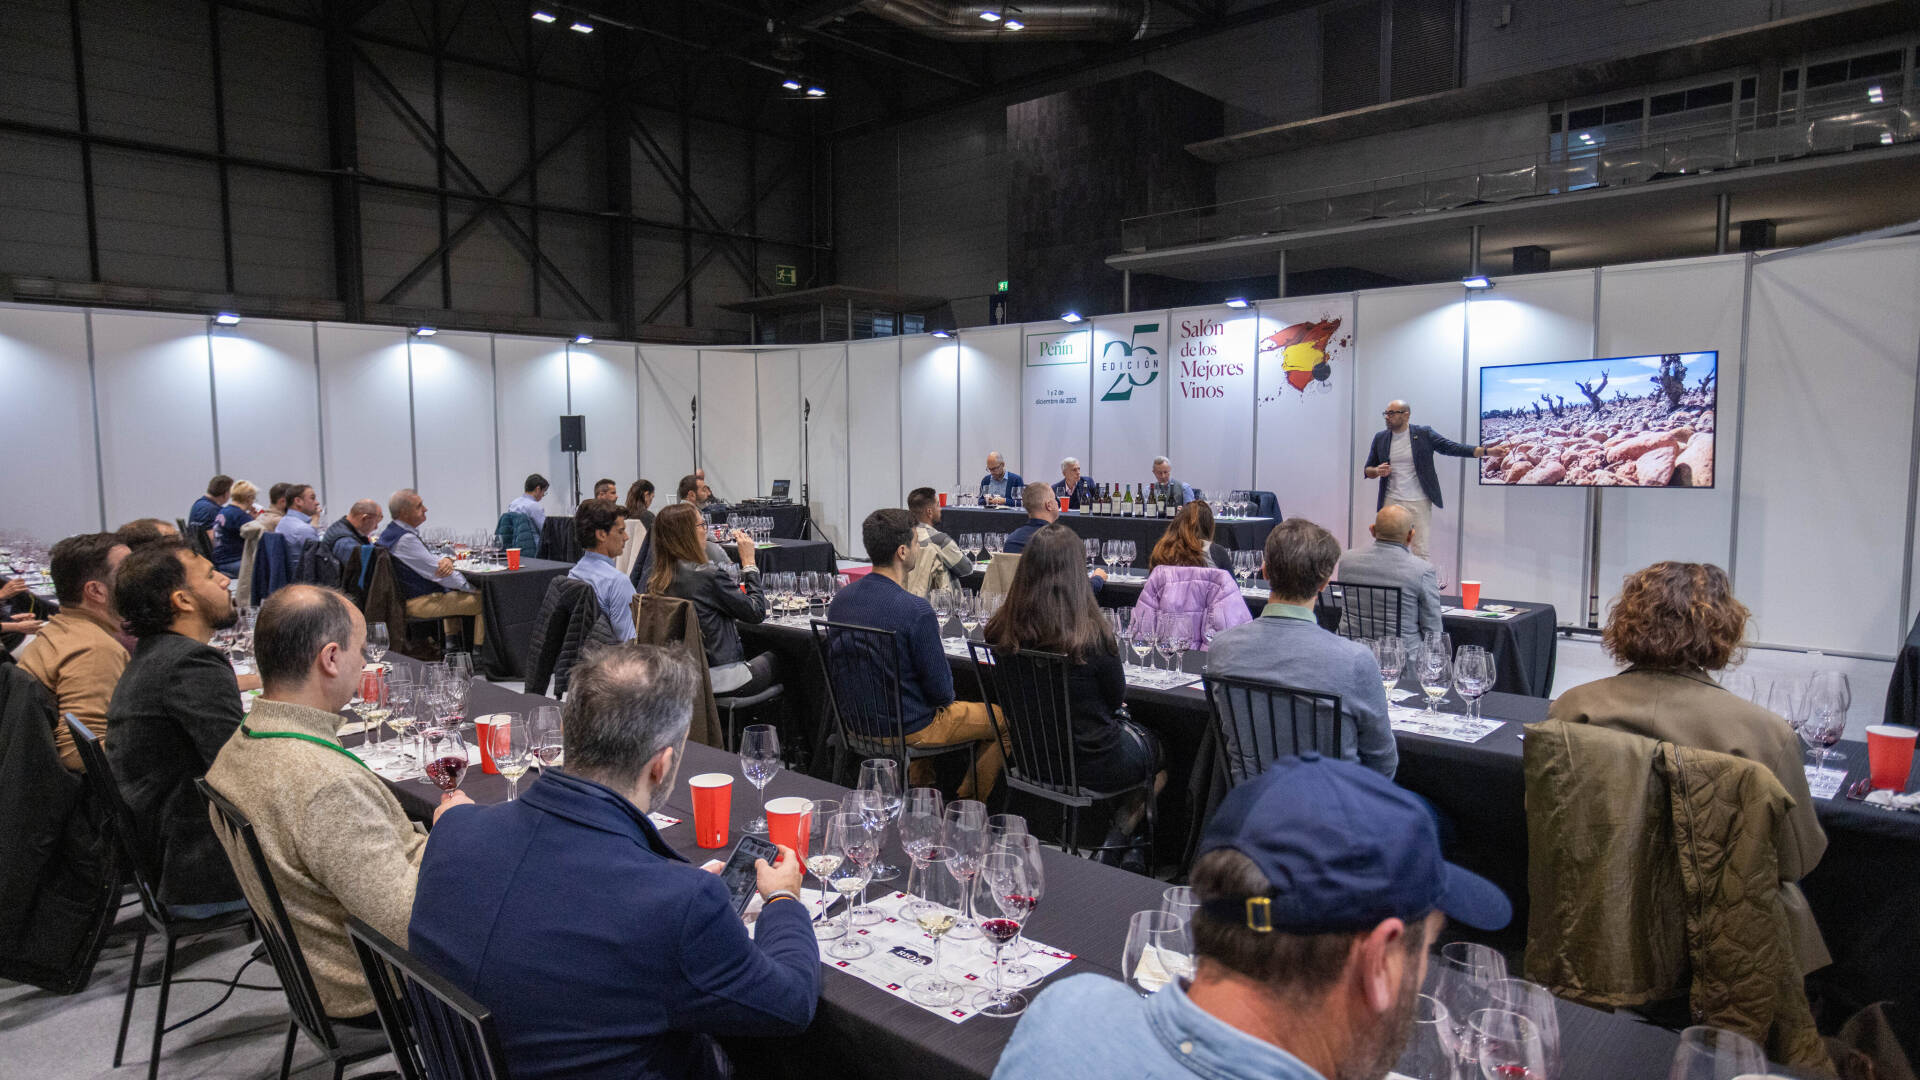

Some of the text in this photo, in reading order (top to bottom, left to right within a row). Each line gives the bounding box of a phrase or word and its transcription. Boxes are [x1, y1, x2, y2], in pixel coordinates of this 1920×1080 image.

[1180, 319, 1224, 339] Salón
[1040, 340, 1073, 357] Peñín
[1180, 340, 1217, 358] de los
[1101, 323, 1160, 401] 25
[1102, 356, 1159, 371] EDICIÓN
[1180, 360, 1244, 381] Mejores
[1180, 381, 1224, 399] Vinos
